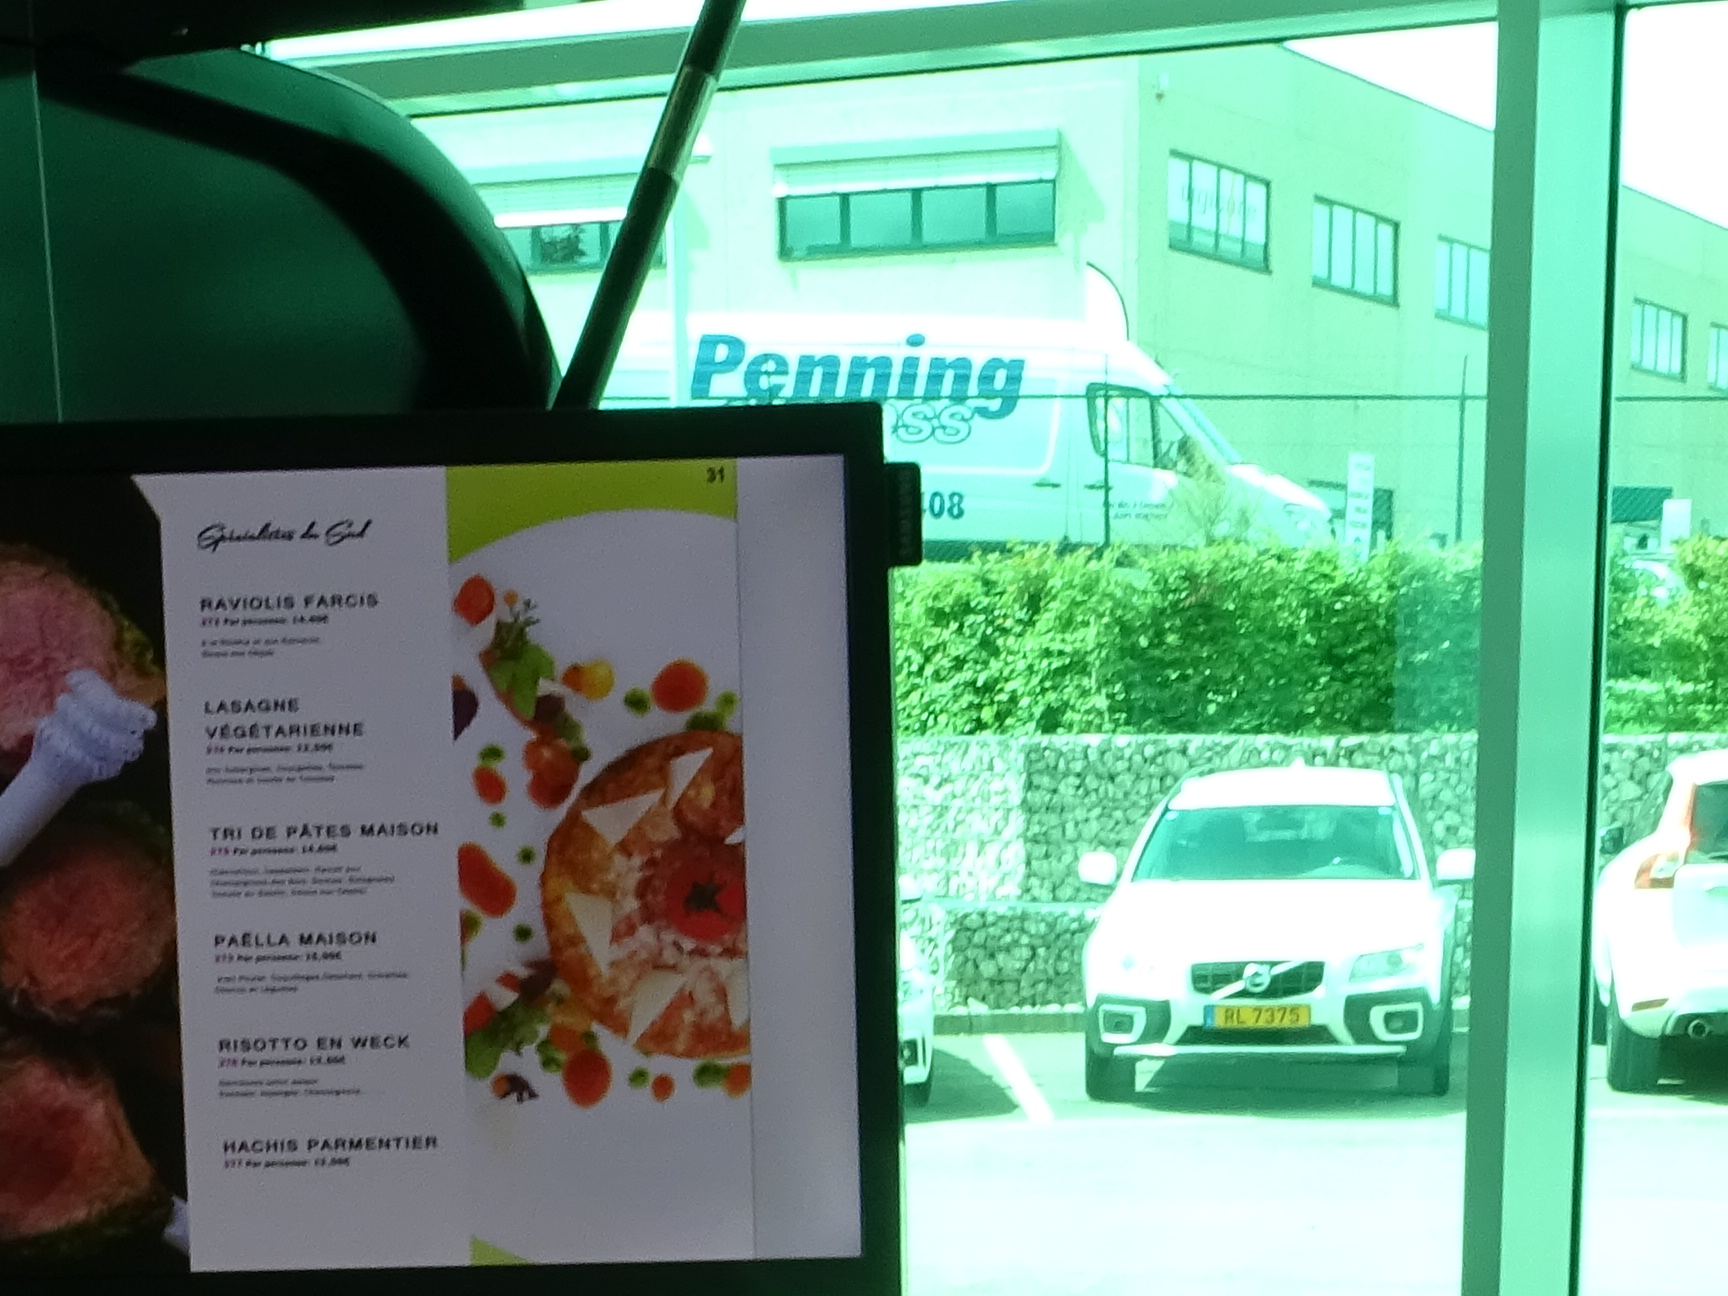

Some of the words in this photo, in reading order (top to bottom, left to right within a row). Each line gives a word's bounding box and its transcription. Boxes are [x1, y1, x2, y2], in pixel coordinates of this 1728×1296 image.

[691, 334, 1025, 419] Penning
[706, 466, 725, 484] 31
[200, 596, 295, 612] RAVIOLIS
[303, 593, 379, 609] FARCIS
[204, 698, 300, 715] LASAGNE
[206, 722, 364, 740] VÉGÉTARIENNE
[209, 826, 242, 841] TRI
[250, 825, 277, 840] DE
[286, 822, 351, 839] PÂTES
[360, 821, 439, 837] MAISON
[214, 931, 290, 948] PAËLLA
[299, 930, 377, 946] MAISON
[1224, 1007, 1245, 1025] RL
[1252, 1006, 1301, 1024] 7375
[218, 1037, 308, 1053] RISOTTO
[317, 1035, 343, 1050] EN
[351, 1034, 410, 1049] WECK
[223, 1138, 298, 1154] HACHIS
[306, 1136, 438, 1151] PARMENTIER
